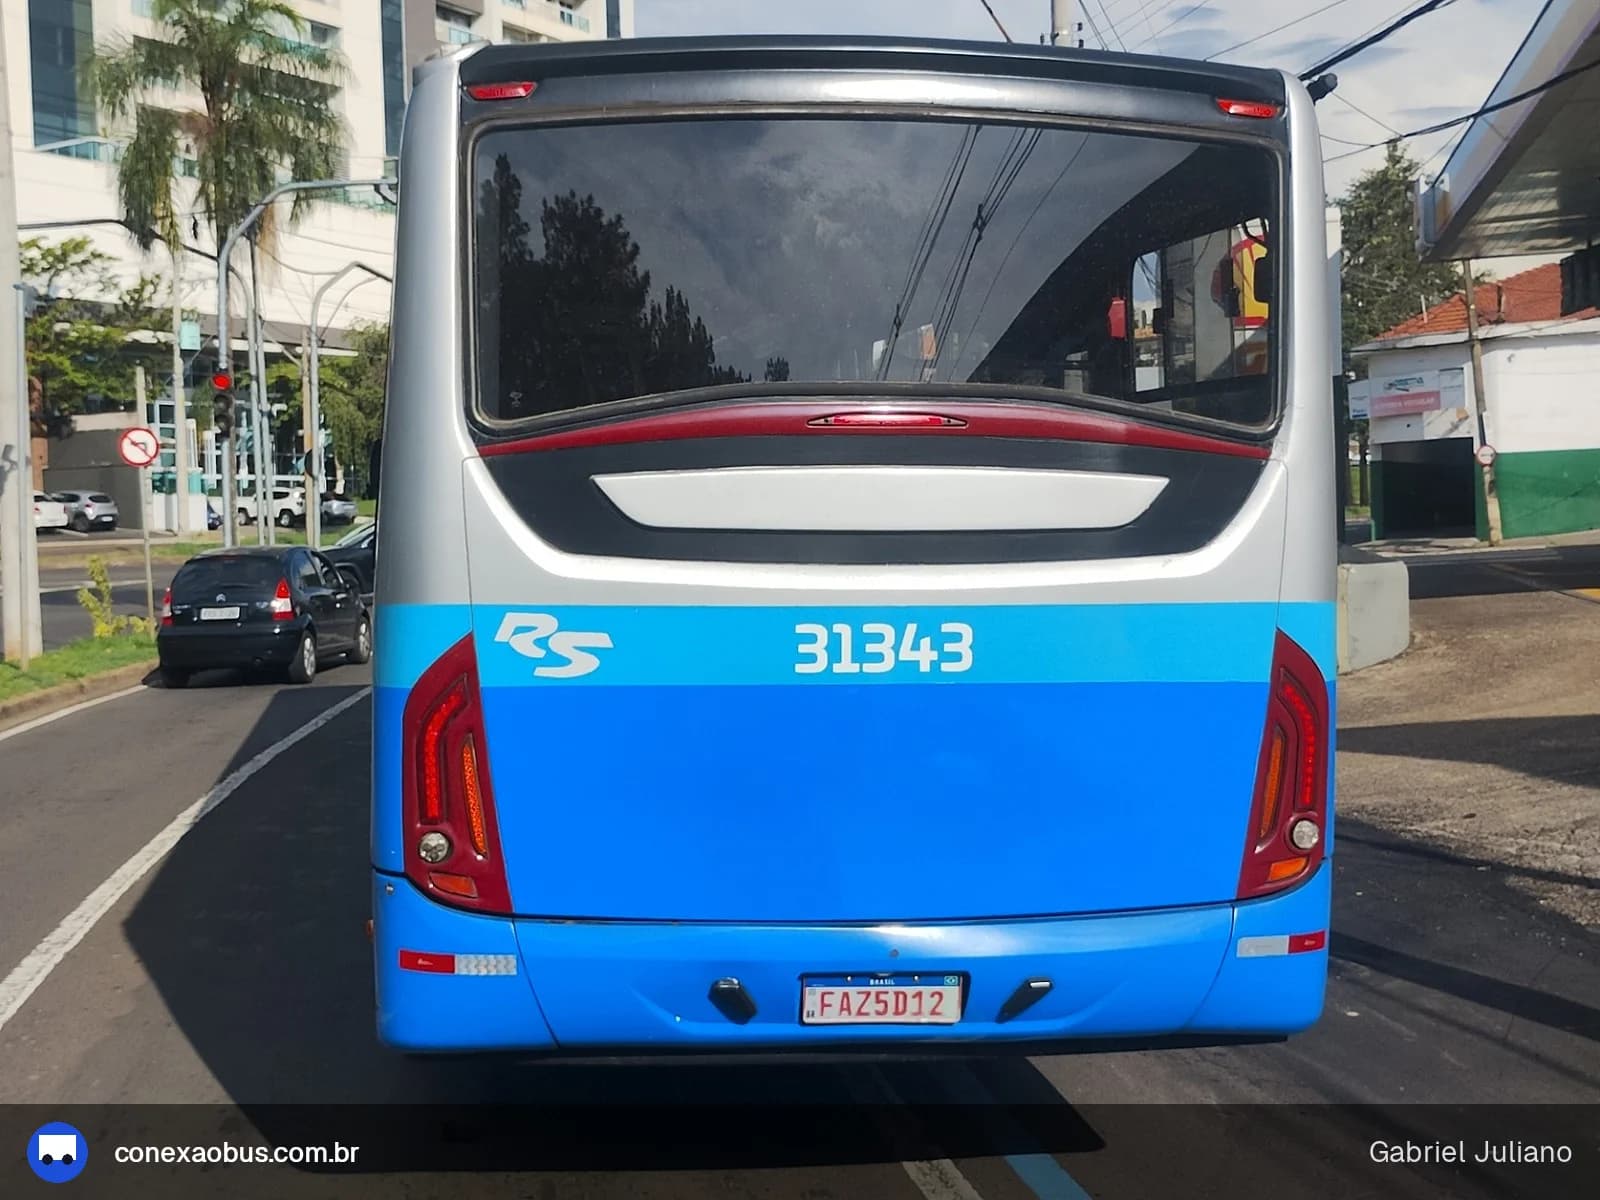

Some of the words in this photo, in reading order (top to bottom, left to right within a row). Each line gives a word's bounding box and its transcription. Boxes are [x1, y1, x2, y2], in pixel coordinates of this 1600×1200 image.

[494, 612, 614, 678] RS
[795, 623, 974, 674] 31343
[869, 978, 896, 986] BRASIL
[820, 991, 944, 1017] FAZ5D12
